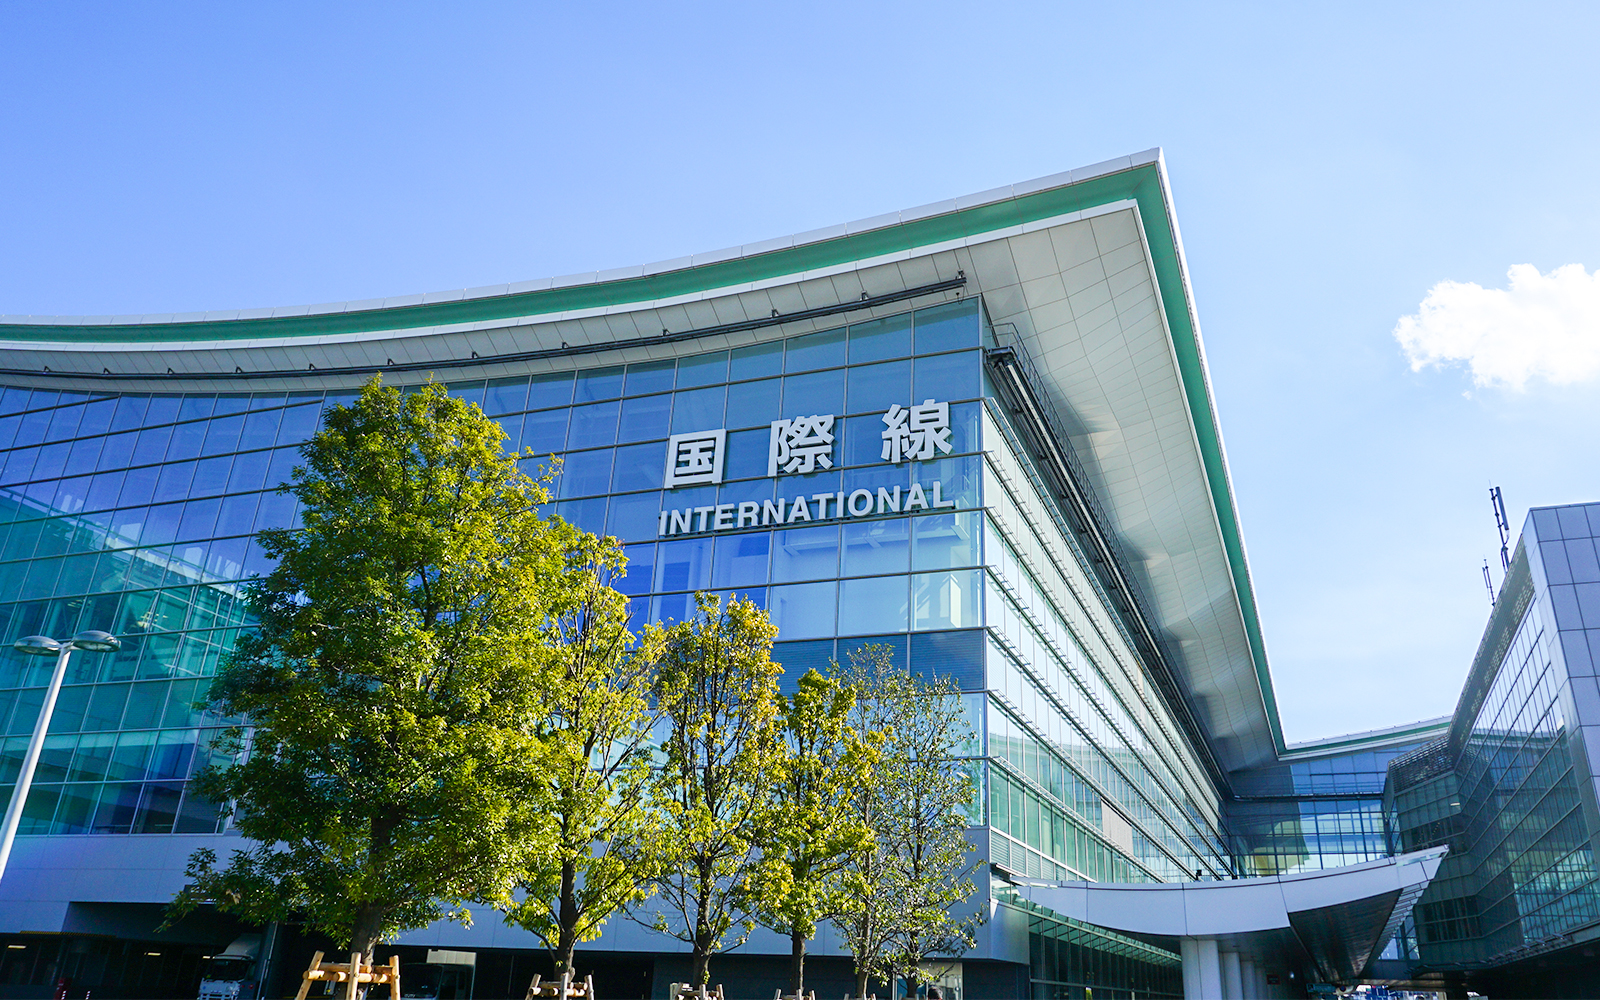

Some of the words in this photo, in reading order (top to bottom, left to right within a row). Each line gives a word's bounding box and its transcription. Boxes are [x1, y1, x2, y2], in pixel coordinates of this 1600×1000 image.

[664, 398, 953, 489] 国際線
[659, 481, 954, 536] INTERNATIONAL
